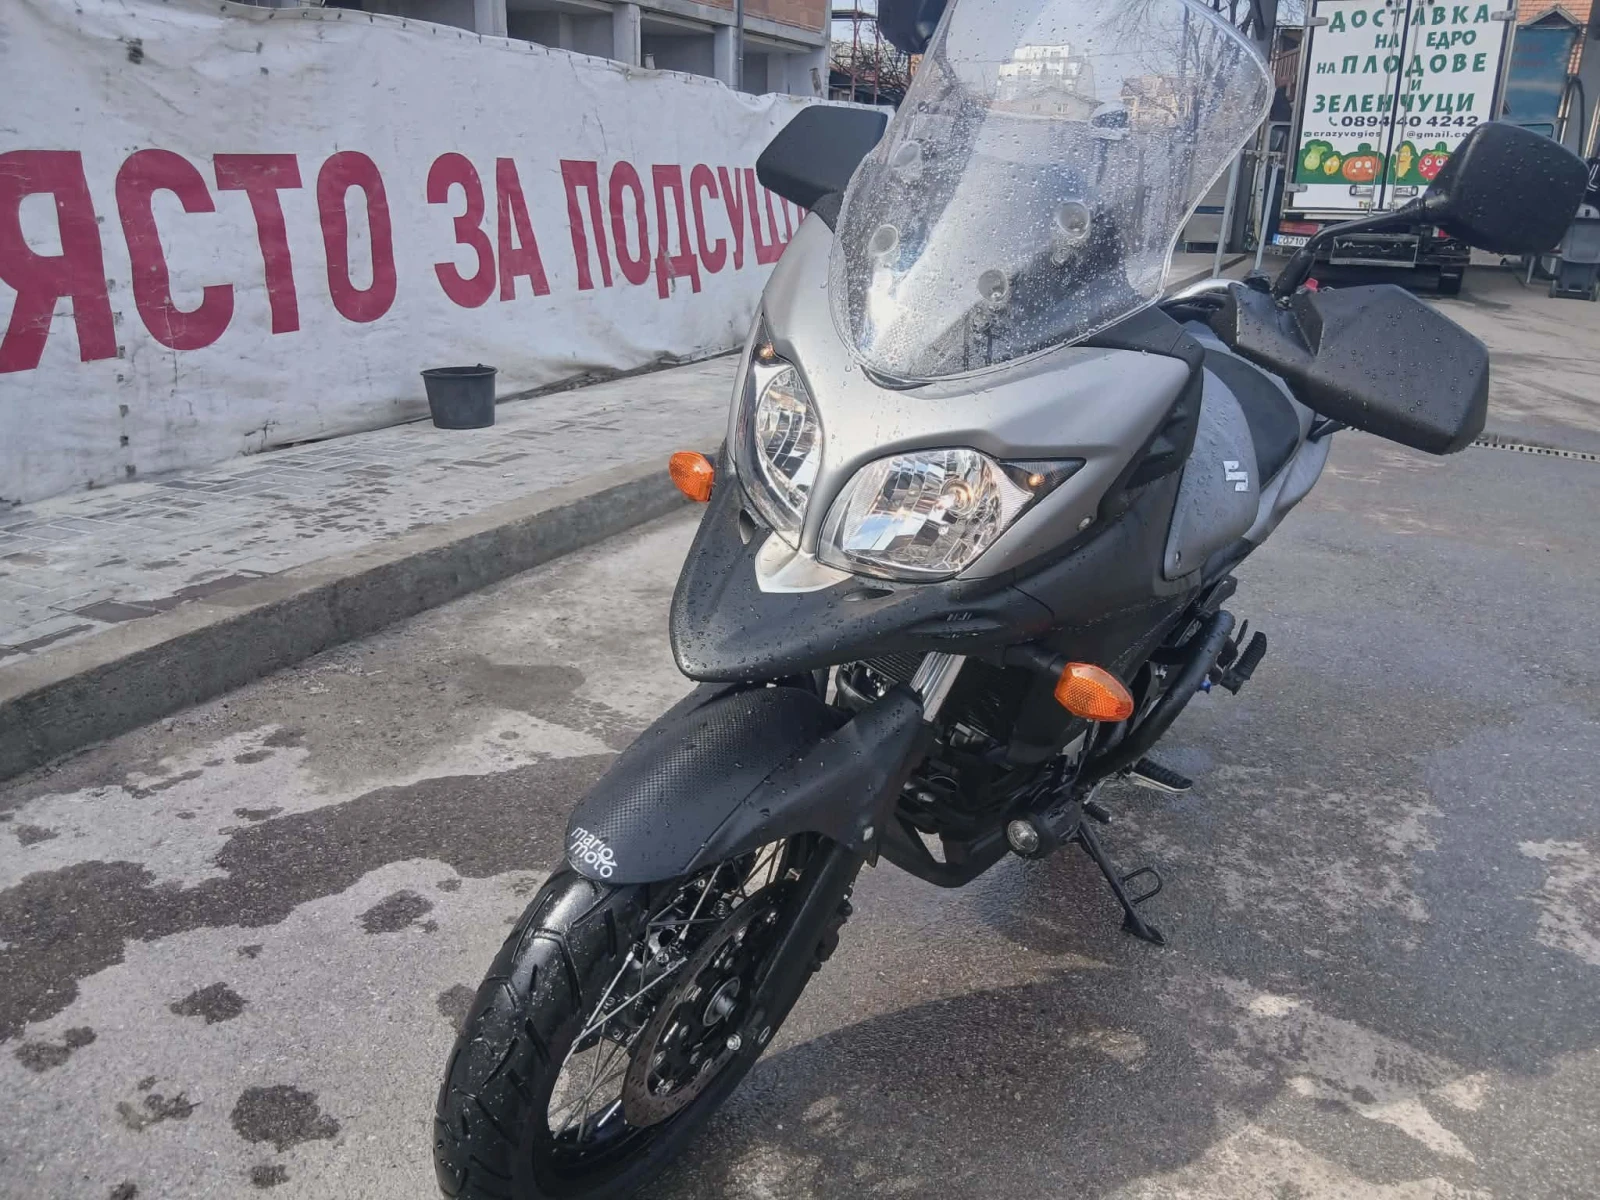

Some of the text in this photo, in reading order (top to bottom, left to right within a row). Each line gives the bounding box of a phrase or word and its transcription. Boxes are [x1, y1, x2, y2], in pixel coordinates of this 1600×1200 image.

[1328, 4, 1490, 33] ДОСТАВКА
[1374, 30, 1477, 50] НА ЕДРО
[1316, 52, 1487, 77] НА ПЛОДОВЕ
[1411, 79, 1422, 91] И
[1312, 92, 1475, 115] ЗЕЛЕНЧУЦИ
[1426, 116, 1479, 127] 4242
[1407, 131, 1469, 139] @gmail.co
[426, 152, 551, 309] ЗА
[559, 158, 809, 300] ПОДСУШ
[571, 827, 614, 861] mario
[570, 841, 618, 878] moto
